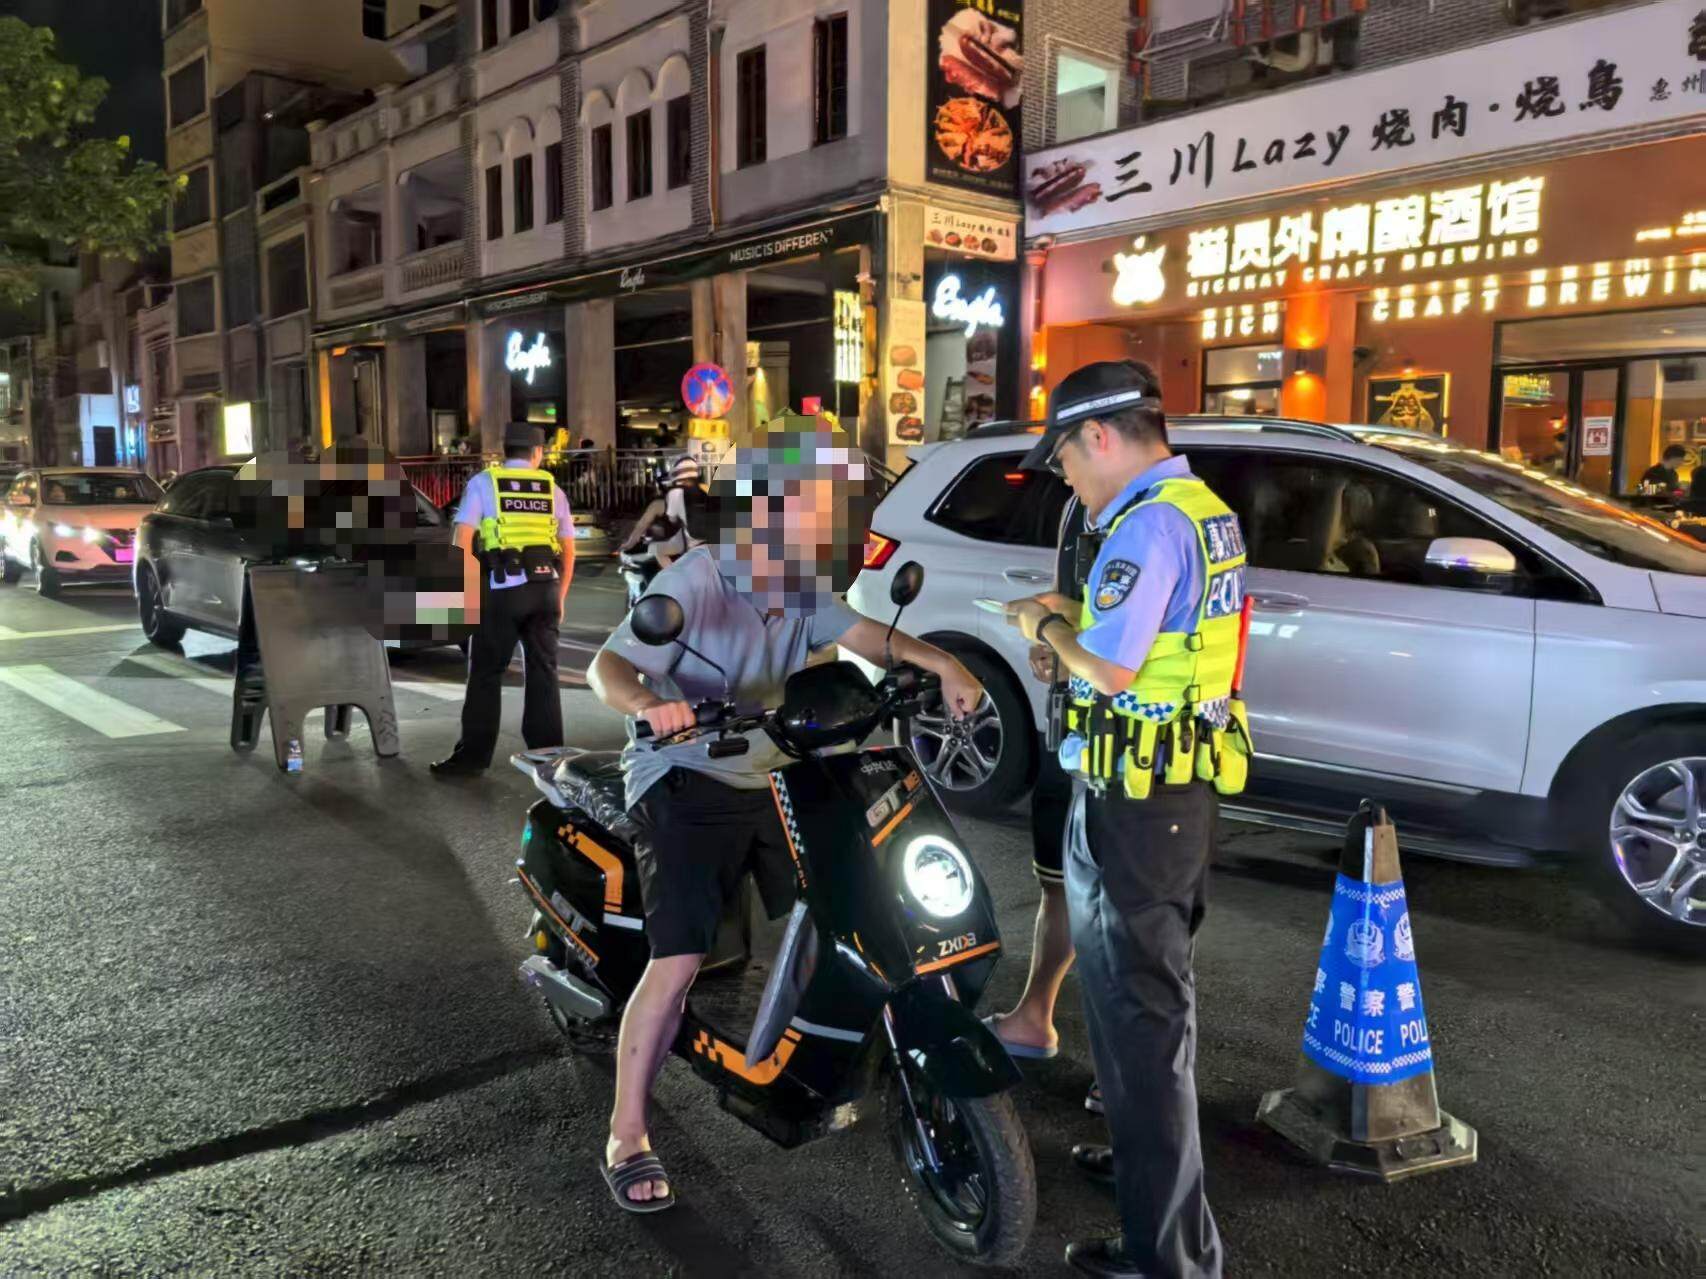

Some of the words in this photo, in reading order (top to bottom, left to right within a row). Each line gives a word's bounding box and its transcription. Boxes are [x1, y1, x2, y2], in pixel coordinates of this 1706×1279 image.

[1105, 131, 1214, 202] 三川
[1232, 125, 1349, 173] Lazy
[1303, 258, 1386, 283] CRAFT
[1372, 288, 1500, 322] CRAFT
[505, 499, 549, 512] POLICE
[1339, 980, 1385, 1017] 警察
[1334, 1018, 1385, 1056] POLICE
